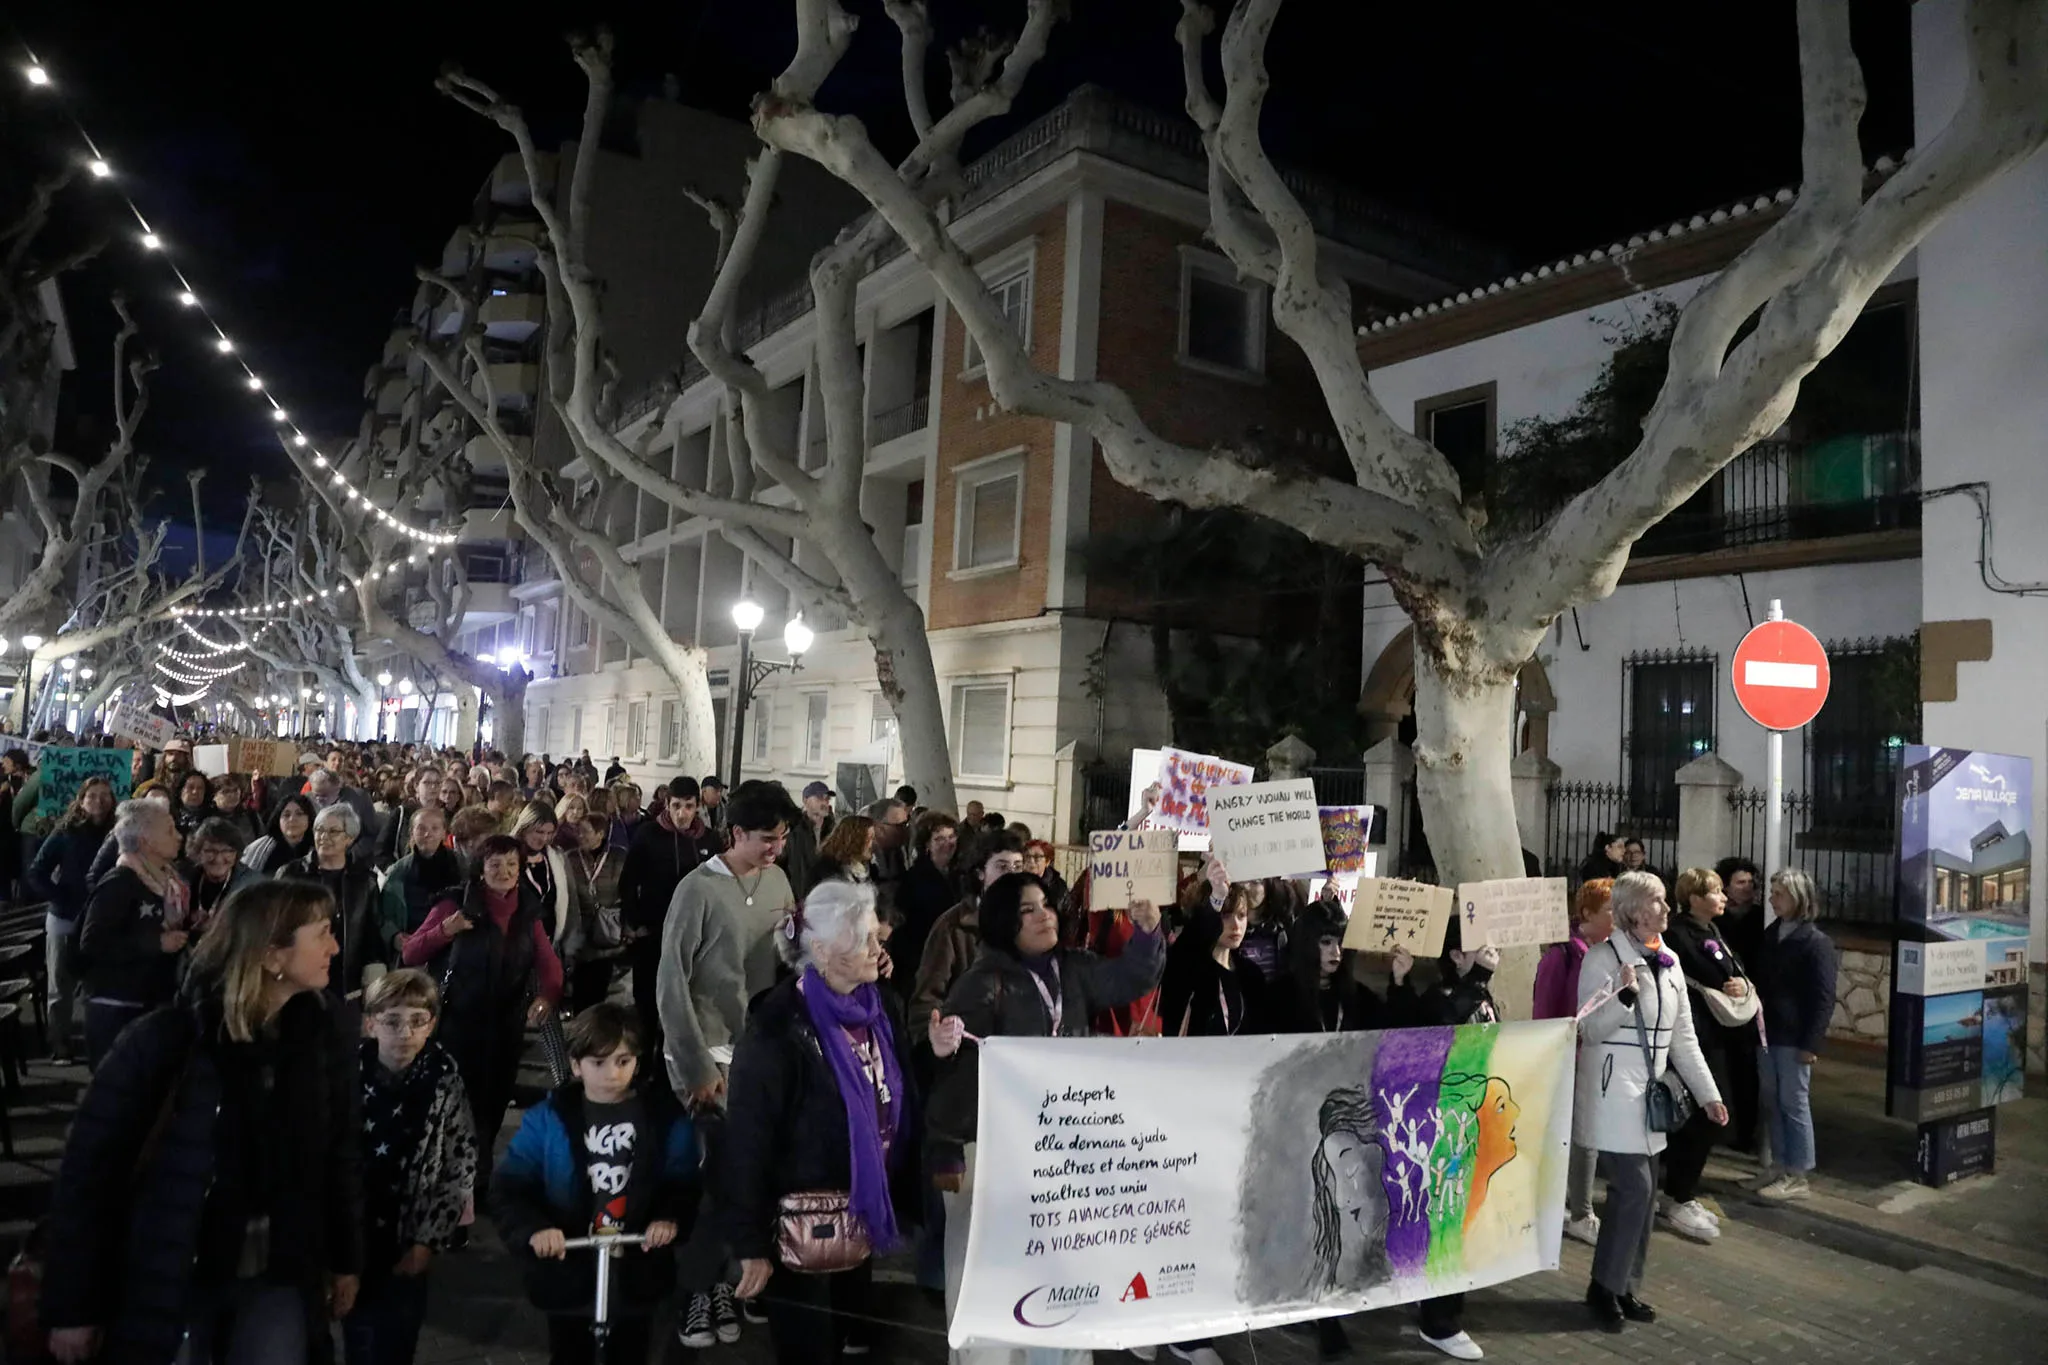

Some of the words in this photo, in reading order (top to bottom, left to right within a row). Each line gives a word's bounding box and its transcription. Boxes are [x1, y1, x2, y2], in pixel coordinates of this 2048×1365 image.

[45, 751, 72, 767] ME
[78, 751, 125, 769] FALTA
[1214, 795, 1253, 811] ANGRY
[1294, 789, 1315, 800] WILL
[1984, 788, 2017, 806] VILLAGE
[1228, 814, 1266, 832] CHANGE
[1269, 812, 1284, 824] THE
[1285, 810, 1312, 821] WORLD
[1092, 834, 1123, 852] SOY
[1128, 834, 1144, 850] LA
[1093, 862, 1113, 880] NO
[1115, 861, 1129, 877] LA
[1042, 1089, 1057, 1108] jo
[1062, 1085, 1115, 1106] desperte
[1038, 1111, 1053, 1126] tu
[1058, 1111, 1124, 1126] reacciones
[584, 1121, 637, 1157] NGR
[1034, 1133, 1065, 1152] ella
[1068, 1134, 1126, 1151] demana
[1130, 1127, 1168, 1151] ajuda
[1033, 1158, 1095, 1178] nosaltres
[1099, 1157, 1113, 1172] et
[1116, 1155, 1159, 1172] donem
[1162, 1151, 1198, 1173] suport
[1030, 1183, 1091, 1204] vosaltres
[1095, 1184, 1116, 1197] vos
[1119, 1180, 1148, 1194] uniu
[1029, 1211, 1061, 1229] TOTS
[1068, 1203, 1135, 1225] AVANCEM
[1137, 1197, 1186, 1215] CONTRA
[1025, 1239, 1045, 1256] LA
[1051, 1230, 1117, 1252] VIOLENCIA
[1119, 1227, 1138, 1245] DE
[1159, 1262, 1196, 1275] ADAMA
[1047, 1282, 1100, 1304] Matria
